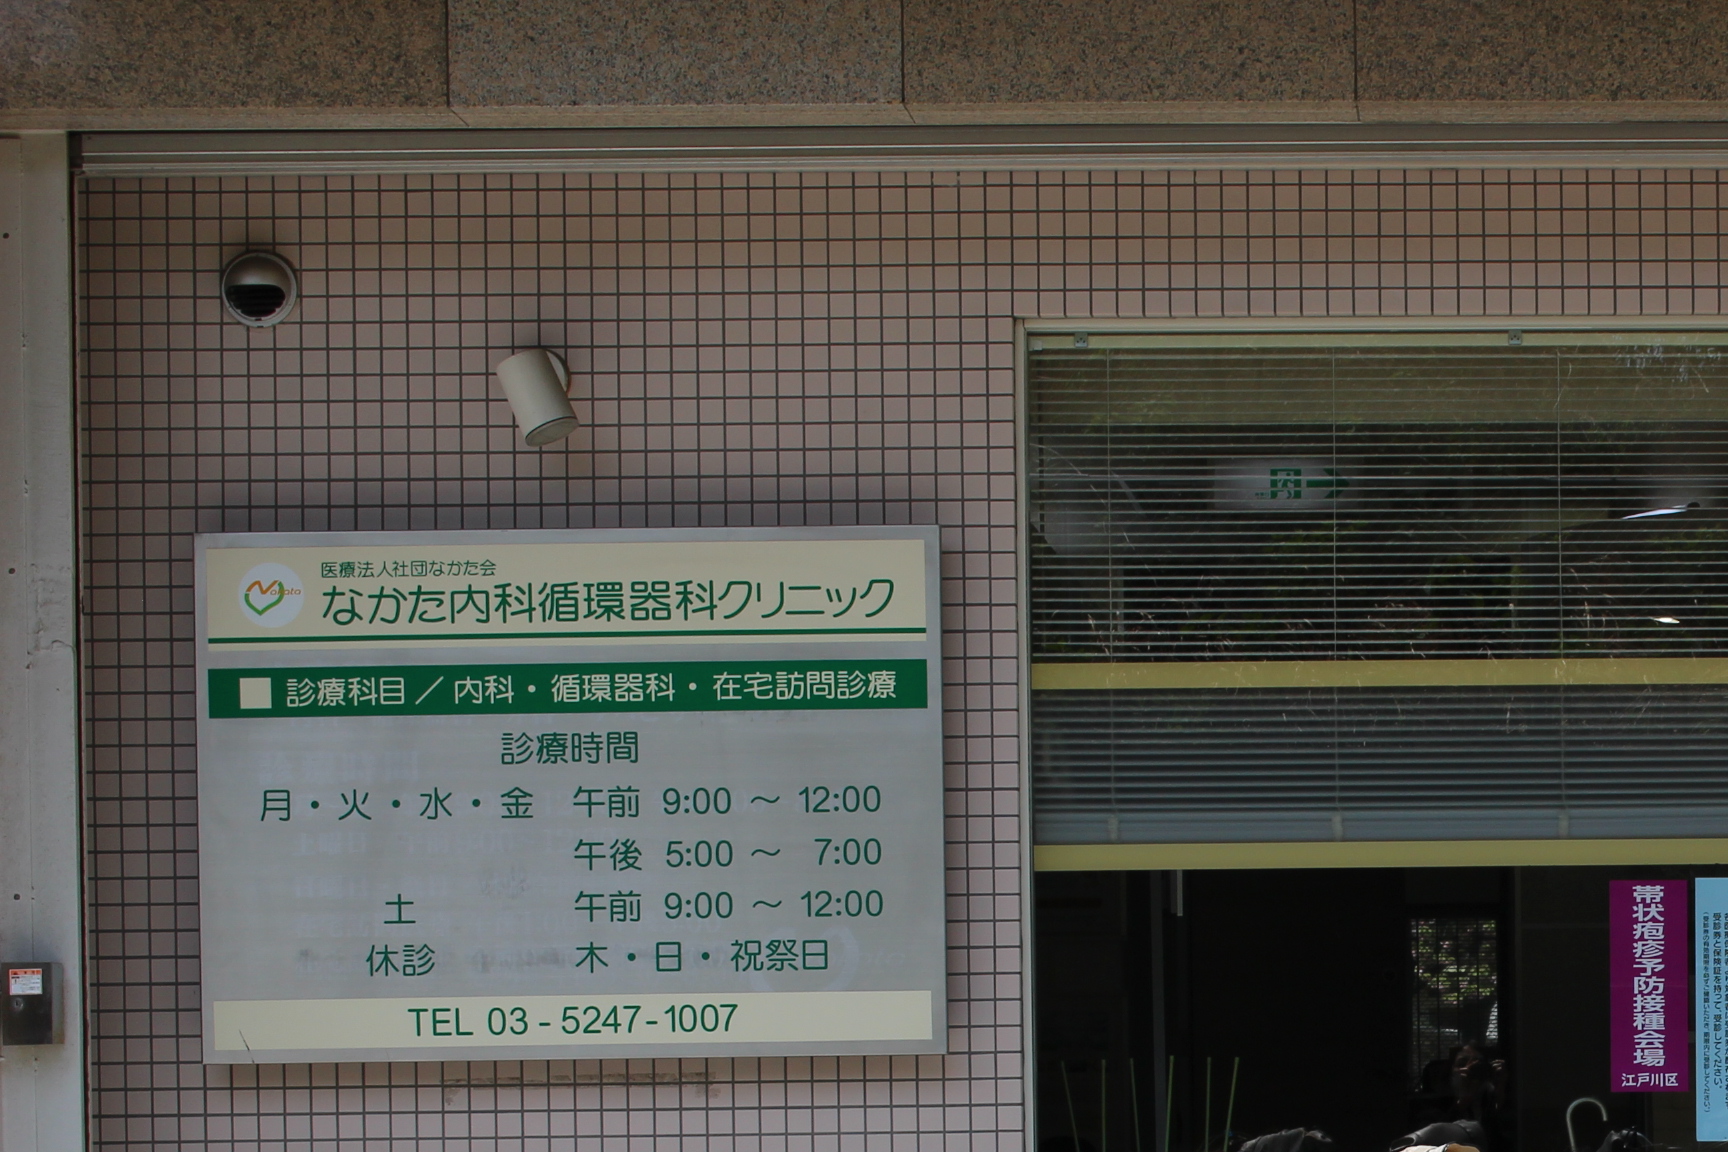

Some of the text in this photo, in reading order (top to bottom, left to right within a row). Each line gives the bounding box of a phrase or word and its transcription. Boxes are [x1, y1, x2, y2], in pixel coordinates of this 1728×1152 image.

[320, 558, 498, 579] 医療法人社団なかた会
[320, 578, 895, 627] なかた内科循環器科クリニック
[500, 731, 640, 766] 診療時間
[572, 784, 641, 821] 午前
[662, 787, 733, 816] 9:00
[798, 784, 883, 814] 12:00
[573, 838, 643, 873] 午後
[664, 839, 734, 869] 5:00
[813, 838, 883, 867] 7:00
[383, 893, 417, 927] 土
[574, 889, 642, 924] 午前
[664, 891, 734, 921] 9:00
[799, 890, 885, 919] 12:00
[365, 942, 437, 979] 休診
[1631, 884, 1667, 1067] 帯状疱疹予防接種会場
[407, 1007, 474, 1037] TEL
[1621, 1072, 1679, 1088] 江戸川区
